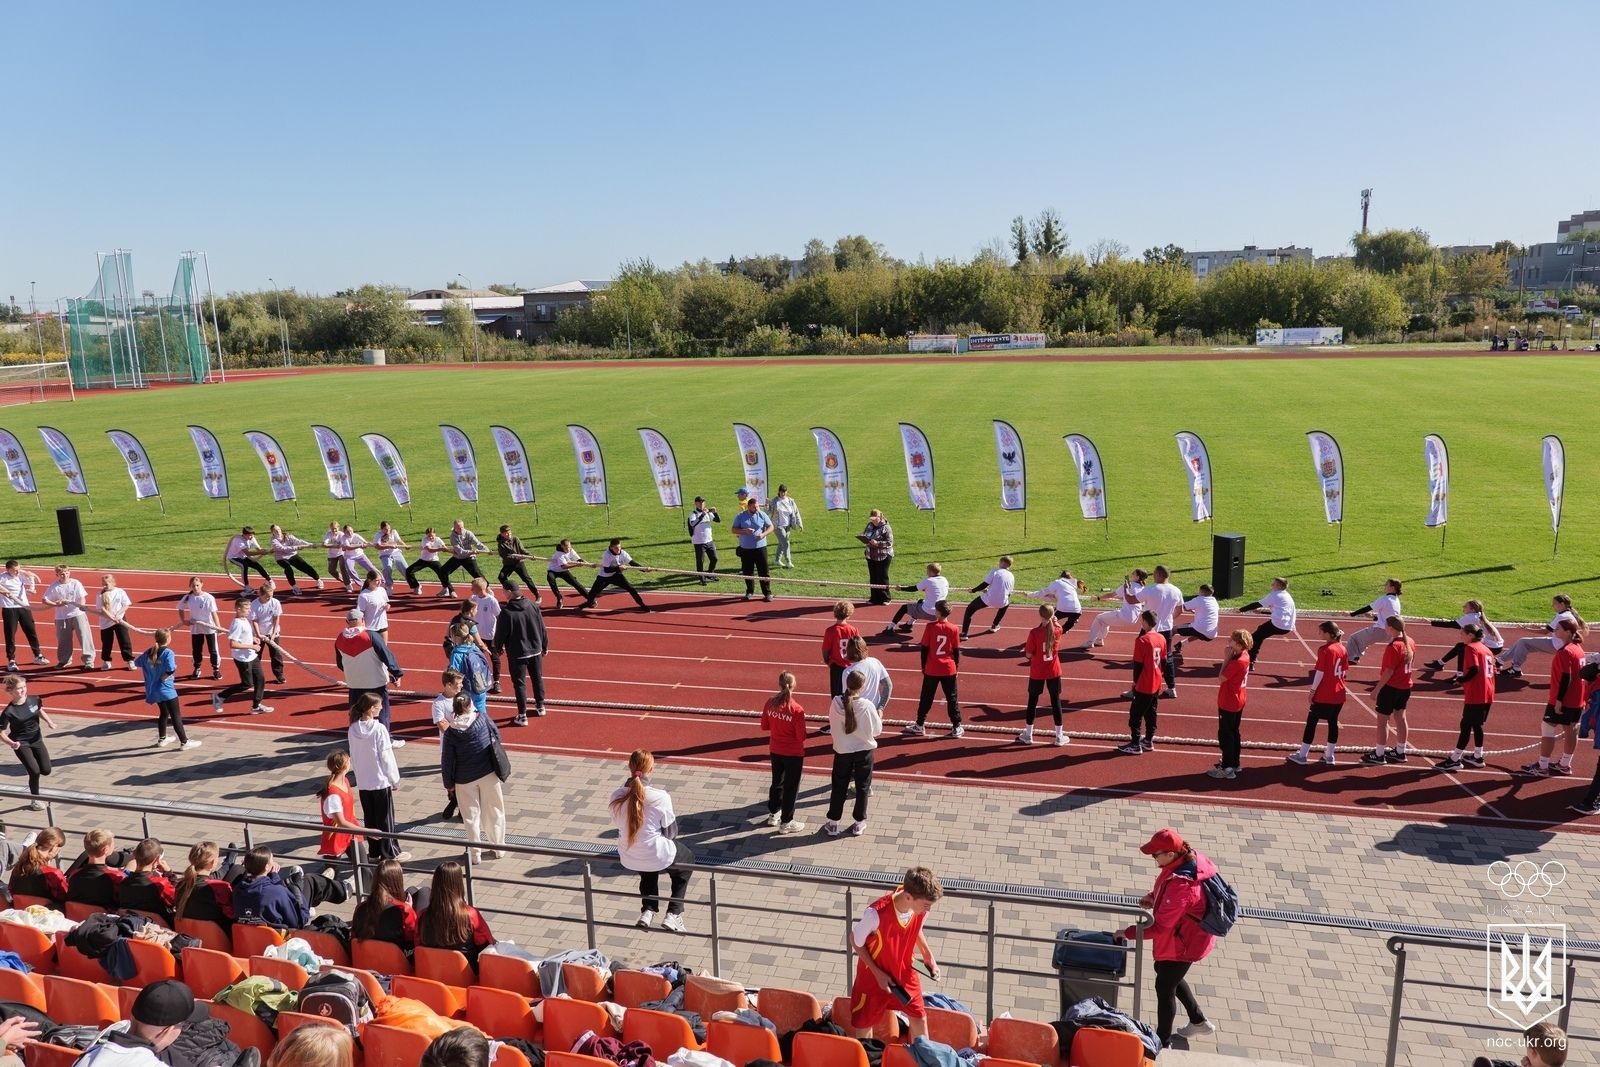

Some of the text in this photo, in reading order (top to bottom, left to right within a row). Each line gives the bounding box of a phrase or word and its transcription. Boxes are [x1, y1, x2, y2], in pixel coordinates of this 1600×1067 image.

[935, 635, 948, 656] 2
[1153, 647, 1162, 669] 9
[1334, 657, 1344, 679] 4
[767, 710, 793, 722] VOLYN
